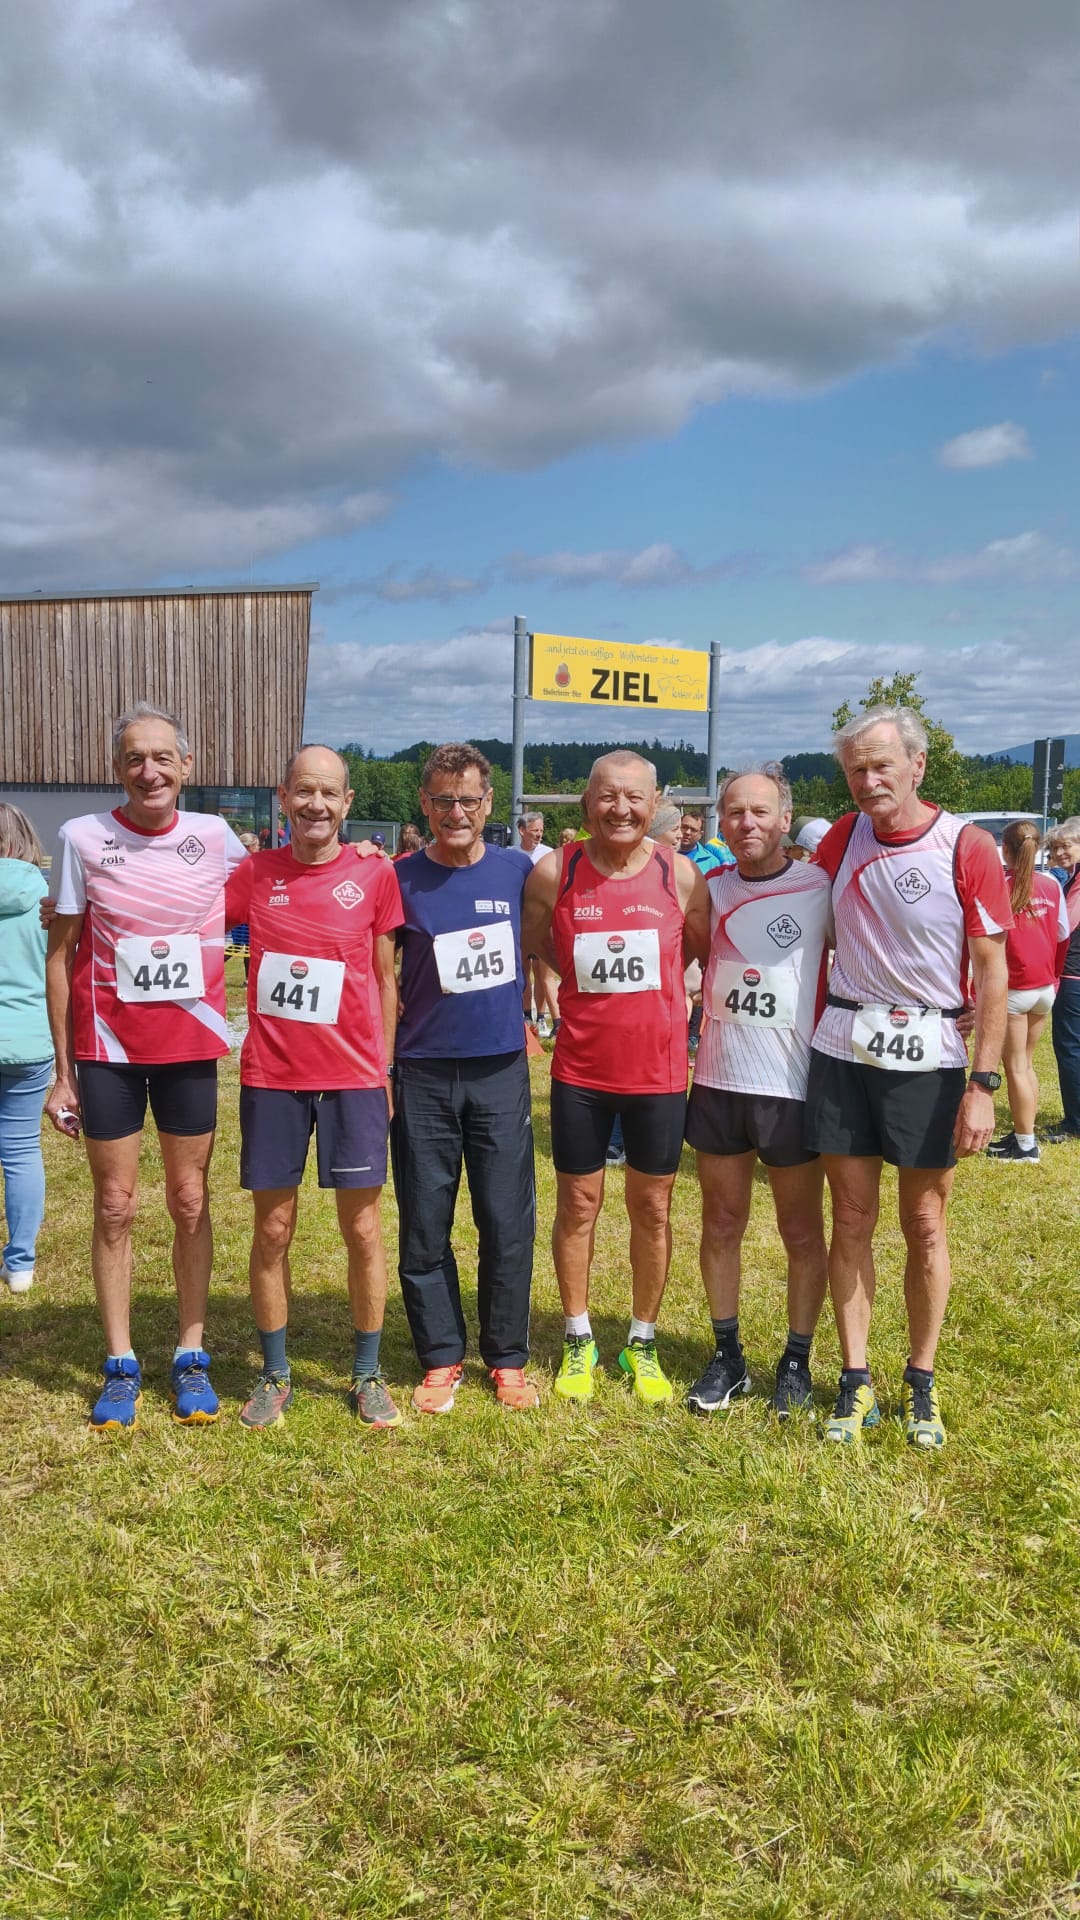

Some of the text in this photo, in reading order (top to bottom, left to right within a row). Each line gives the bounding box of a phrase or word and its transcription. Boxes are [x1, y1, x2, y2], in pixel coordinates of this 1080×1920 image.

[590, 668, 658, 703] ZIEL
[134, 962, 189, 991] 442
[456, 950, 504, 982] 445
[591, 956, 644, 983] 446
[270, 981, 320, 1012] 441
[725, 989, 776, 1018] 443
[867, 1032, 924, 1061] 448
